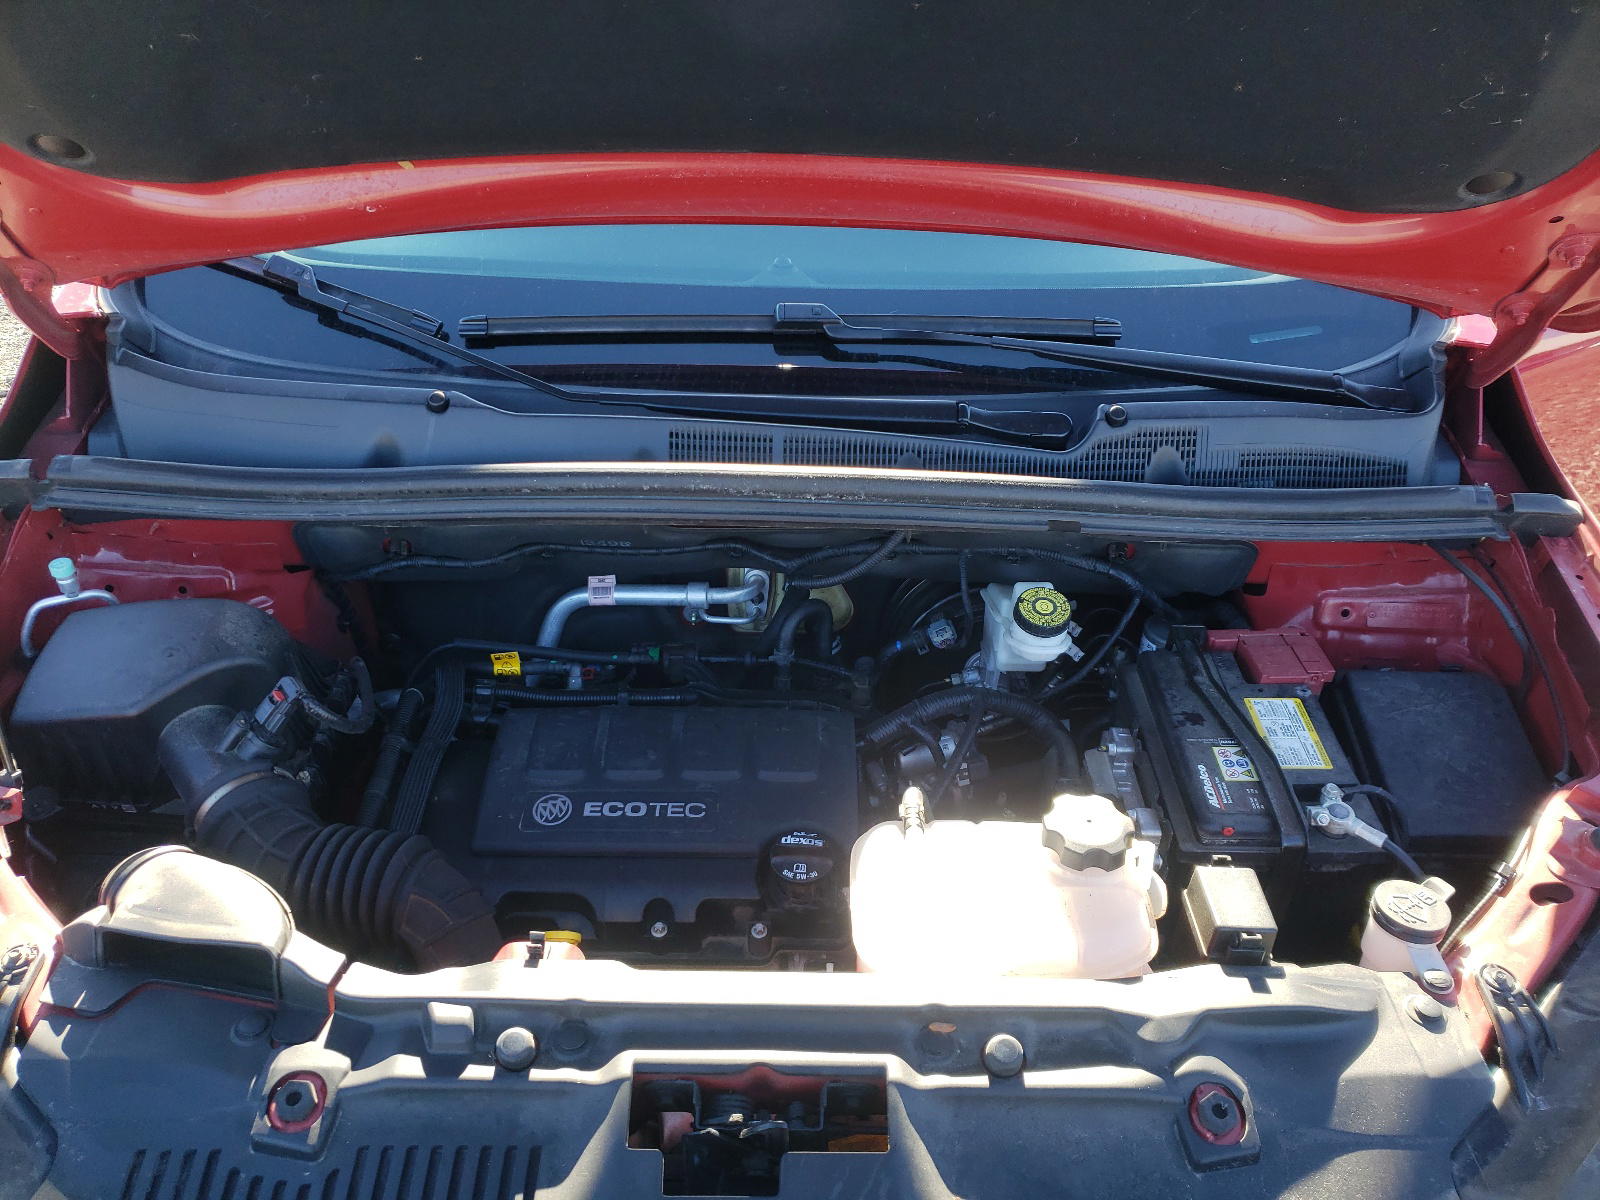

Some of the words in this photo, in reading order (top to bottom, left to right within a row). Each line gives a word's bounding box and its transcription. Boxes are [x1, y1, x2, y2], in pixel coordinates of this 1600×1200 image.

[583, 801, 706, 818] ECOTEC
[781, 835, 823, 846] dexos
[783, 869, 794, 879] SAE
